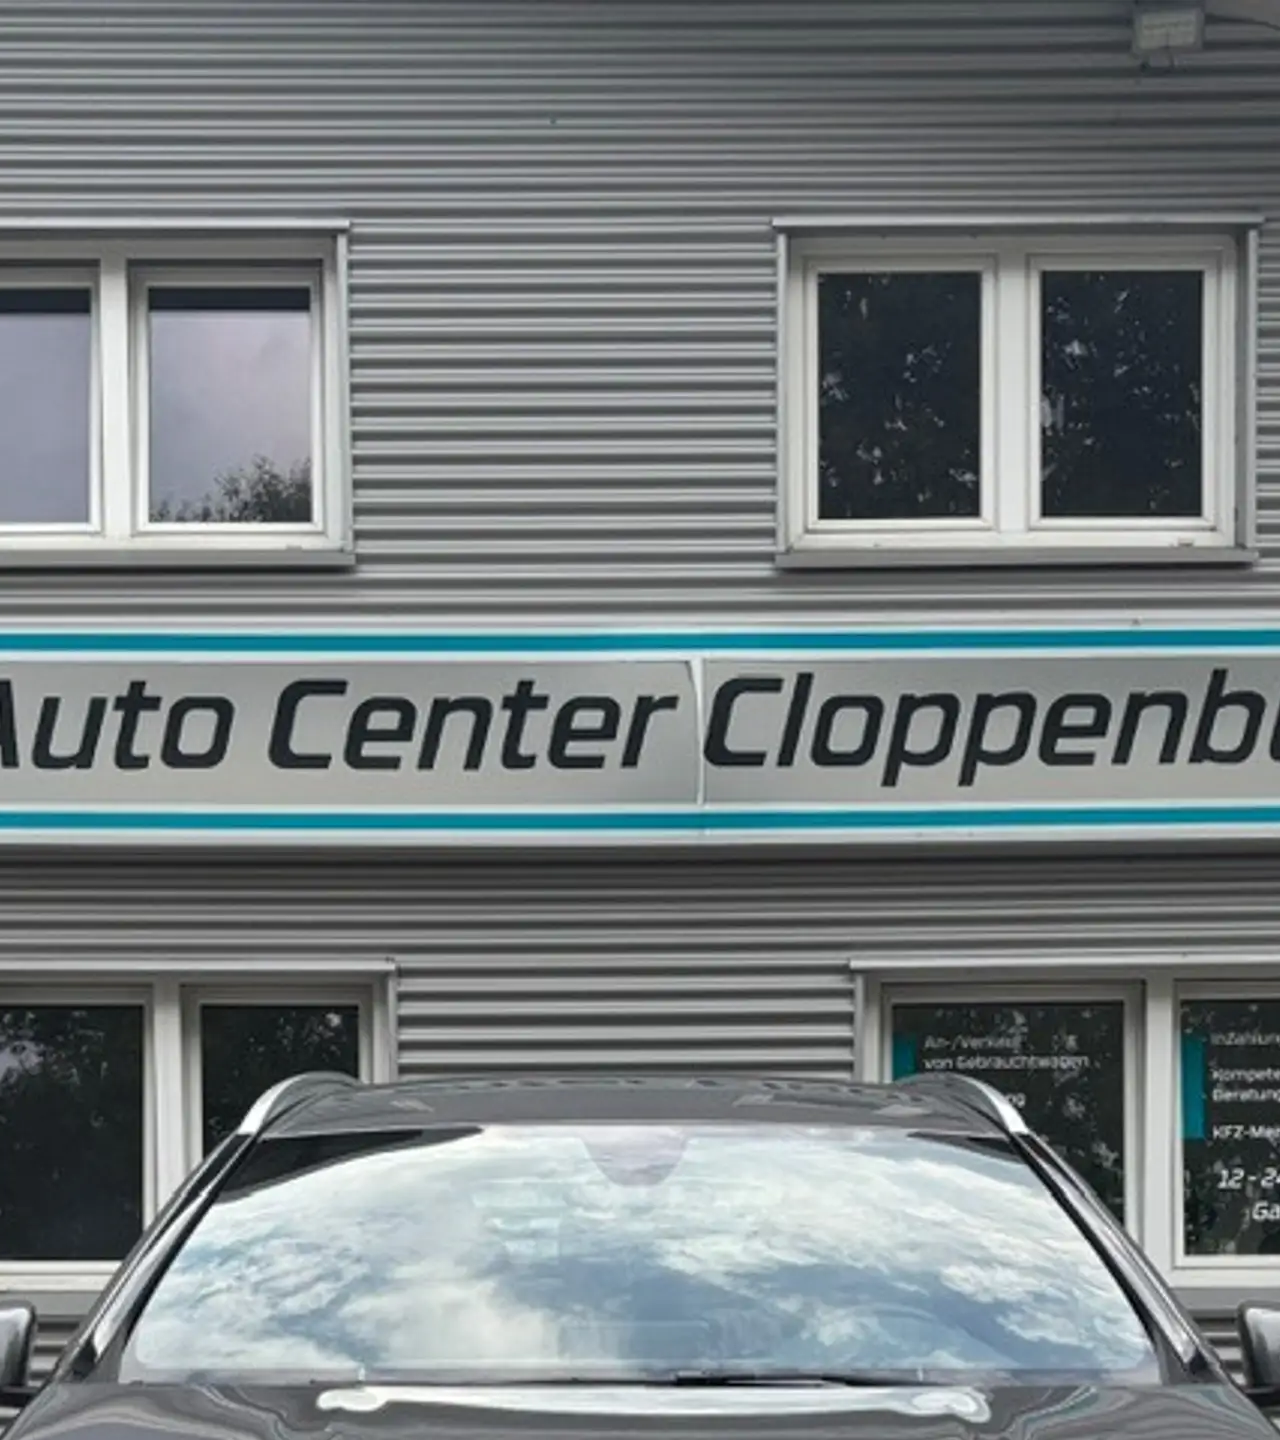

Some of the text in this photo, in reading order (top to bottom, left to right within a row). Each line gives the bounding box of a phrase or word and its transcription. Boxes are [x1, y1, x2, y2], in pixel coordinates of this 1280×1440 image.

[267, 679, 679, 771] Center
[924, 1054, 1089, 1070] von Gebrauchtwagen
[1217, 1168, 1246, 1189] 12
